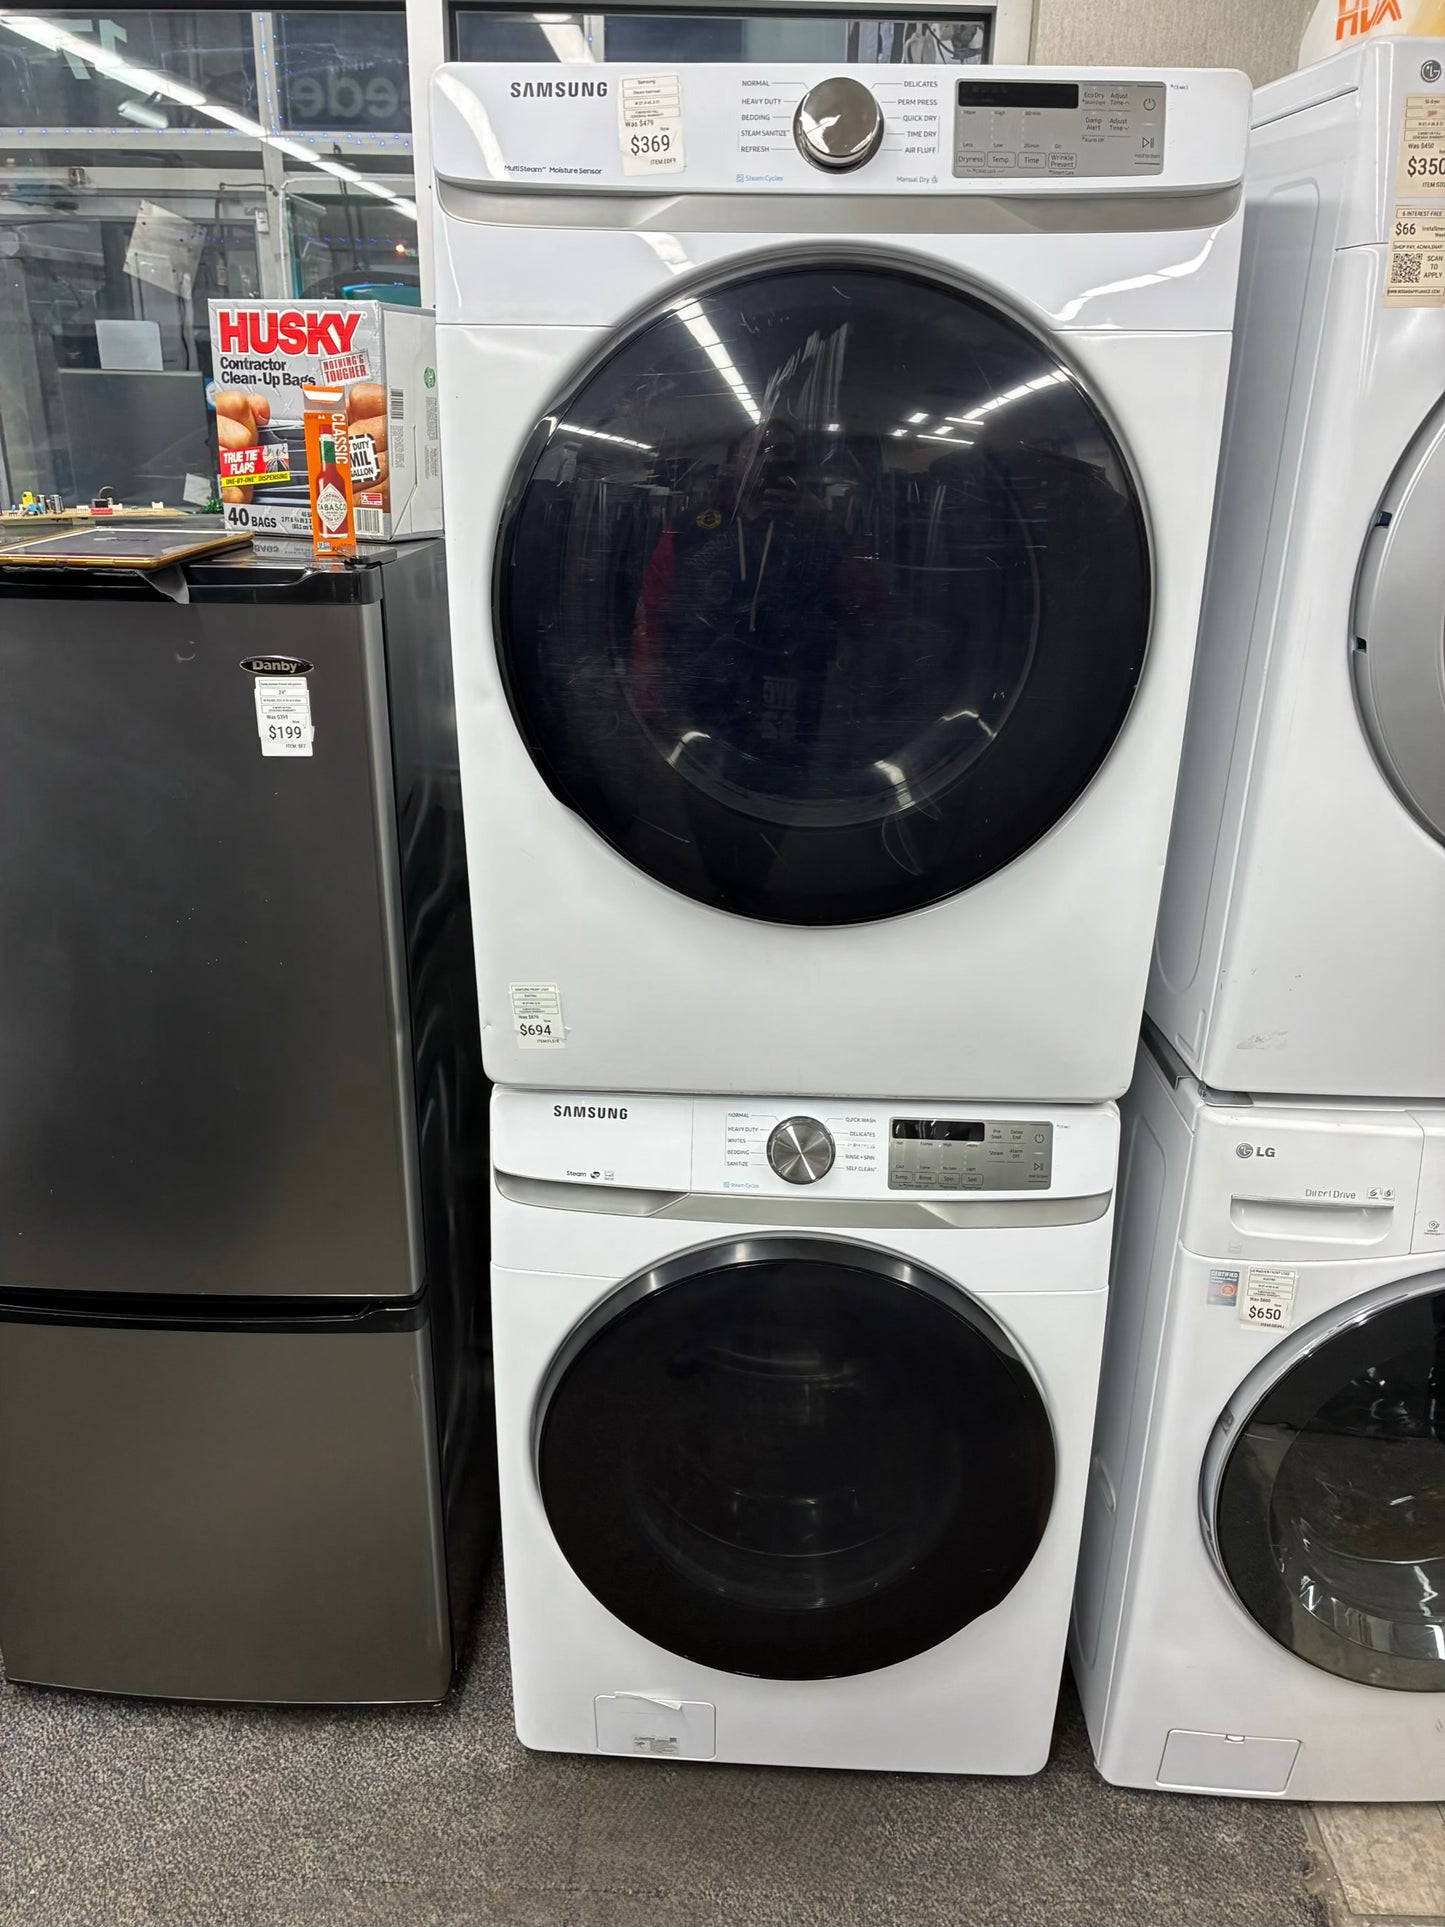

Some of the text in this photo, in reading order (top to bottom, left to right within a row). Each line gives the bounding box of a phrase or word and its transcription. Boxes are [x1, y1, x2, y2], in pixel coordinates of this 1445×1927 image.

[510, 81, 608, 98] SAMSUNG
[631, 134, 670, 156] $369
[959, 155, 983, 164] Dryness
[579, 167, 602, 175] Sensor
[1395, 222, 1416, 236] $66
[219, 312, 361, 355] HUSKY
[220, 357, 287, 371] Contractor
[323, 355, 364, 371] NOTHING'S
[221, 371, 316, 388] Clean-Up Bags
[325, 365, 368, 383] TOUGHER
[331, 413, 349, 465] CLASSIC
[352, 440, 370, 451] DUTY
[223, 450, 244, 464] TRUE
[350, 451, 372, 468] MIL
[231, 461, 255, 475] FLAPS
[258, 472, 288, 482] DISPENSING
[228, 507, 277, 528] 40 BAGS
[252, 660, 298, 673] Danby
[269, 725, 302, 740] $199
[520, 1023, 551, 1036] $694
[553, 1105, 628, 1120] SAMSUNG
[1256, 1146, 1276, 1158] LG
[1333, 1190, 1357, 1199] Drive
[1249, 1306, 1281, 1320] $650
